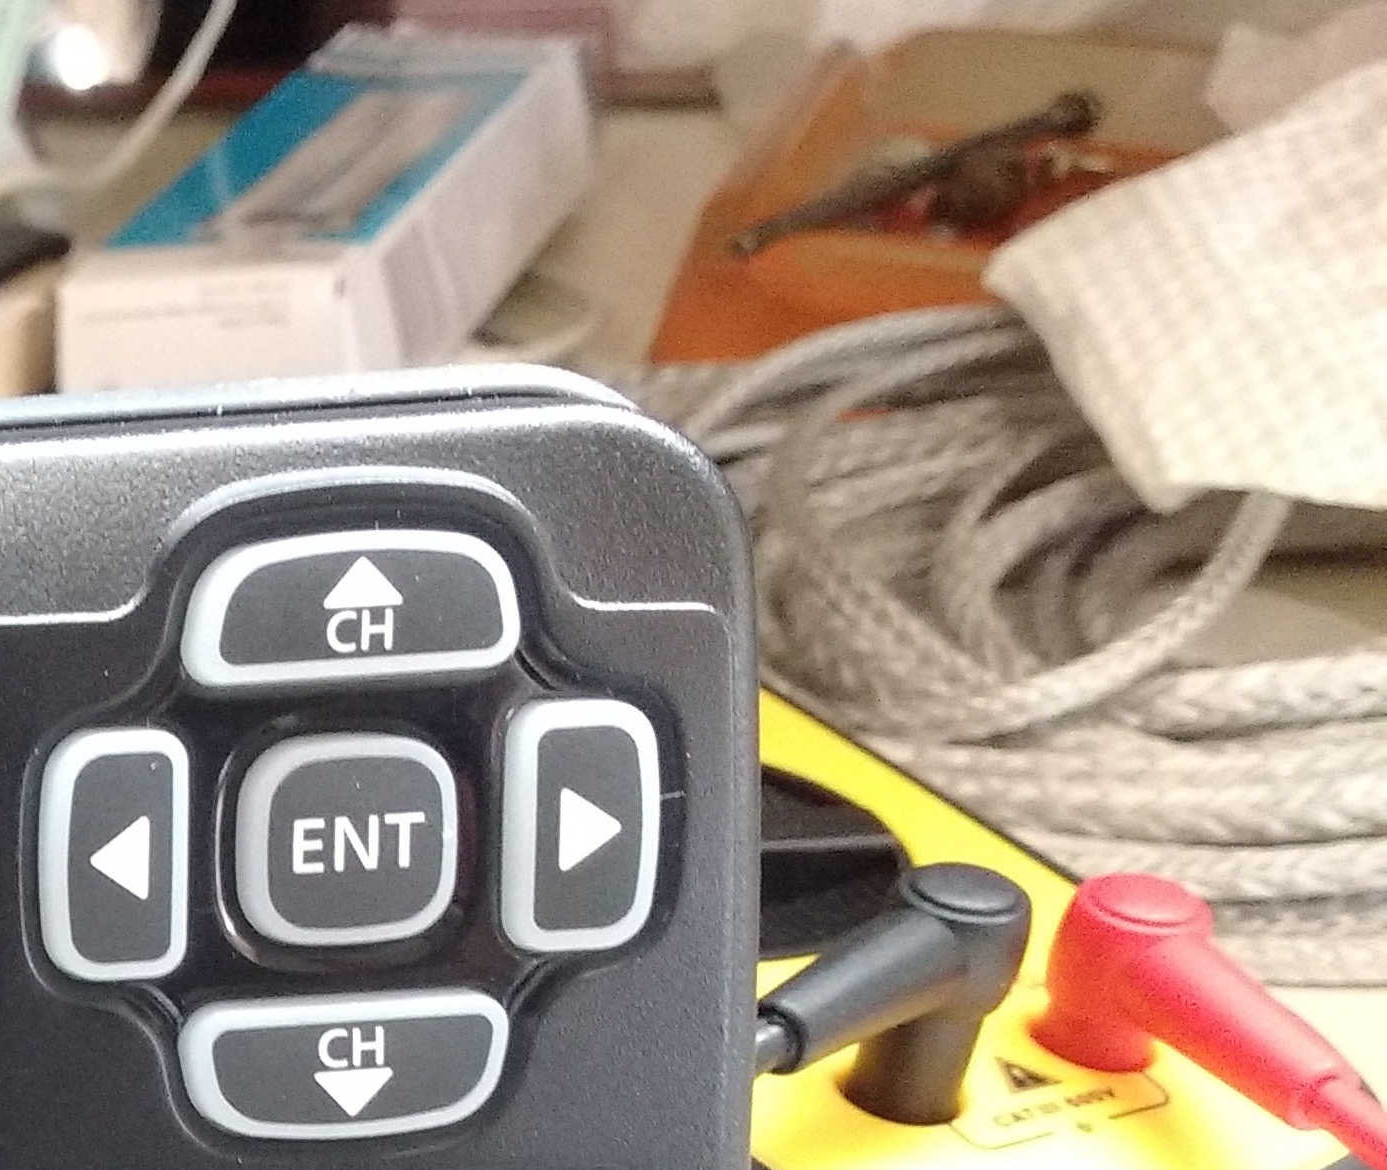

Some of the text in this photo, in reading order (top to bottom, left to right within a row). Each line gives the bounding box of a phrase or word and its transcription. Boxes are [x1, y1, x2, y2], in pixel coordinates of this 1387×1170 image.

[326, 608, 395, 654] CH
[292, 812, 426, 875] ENT
[317, 1026, 386, 1069] CH
